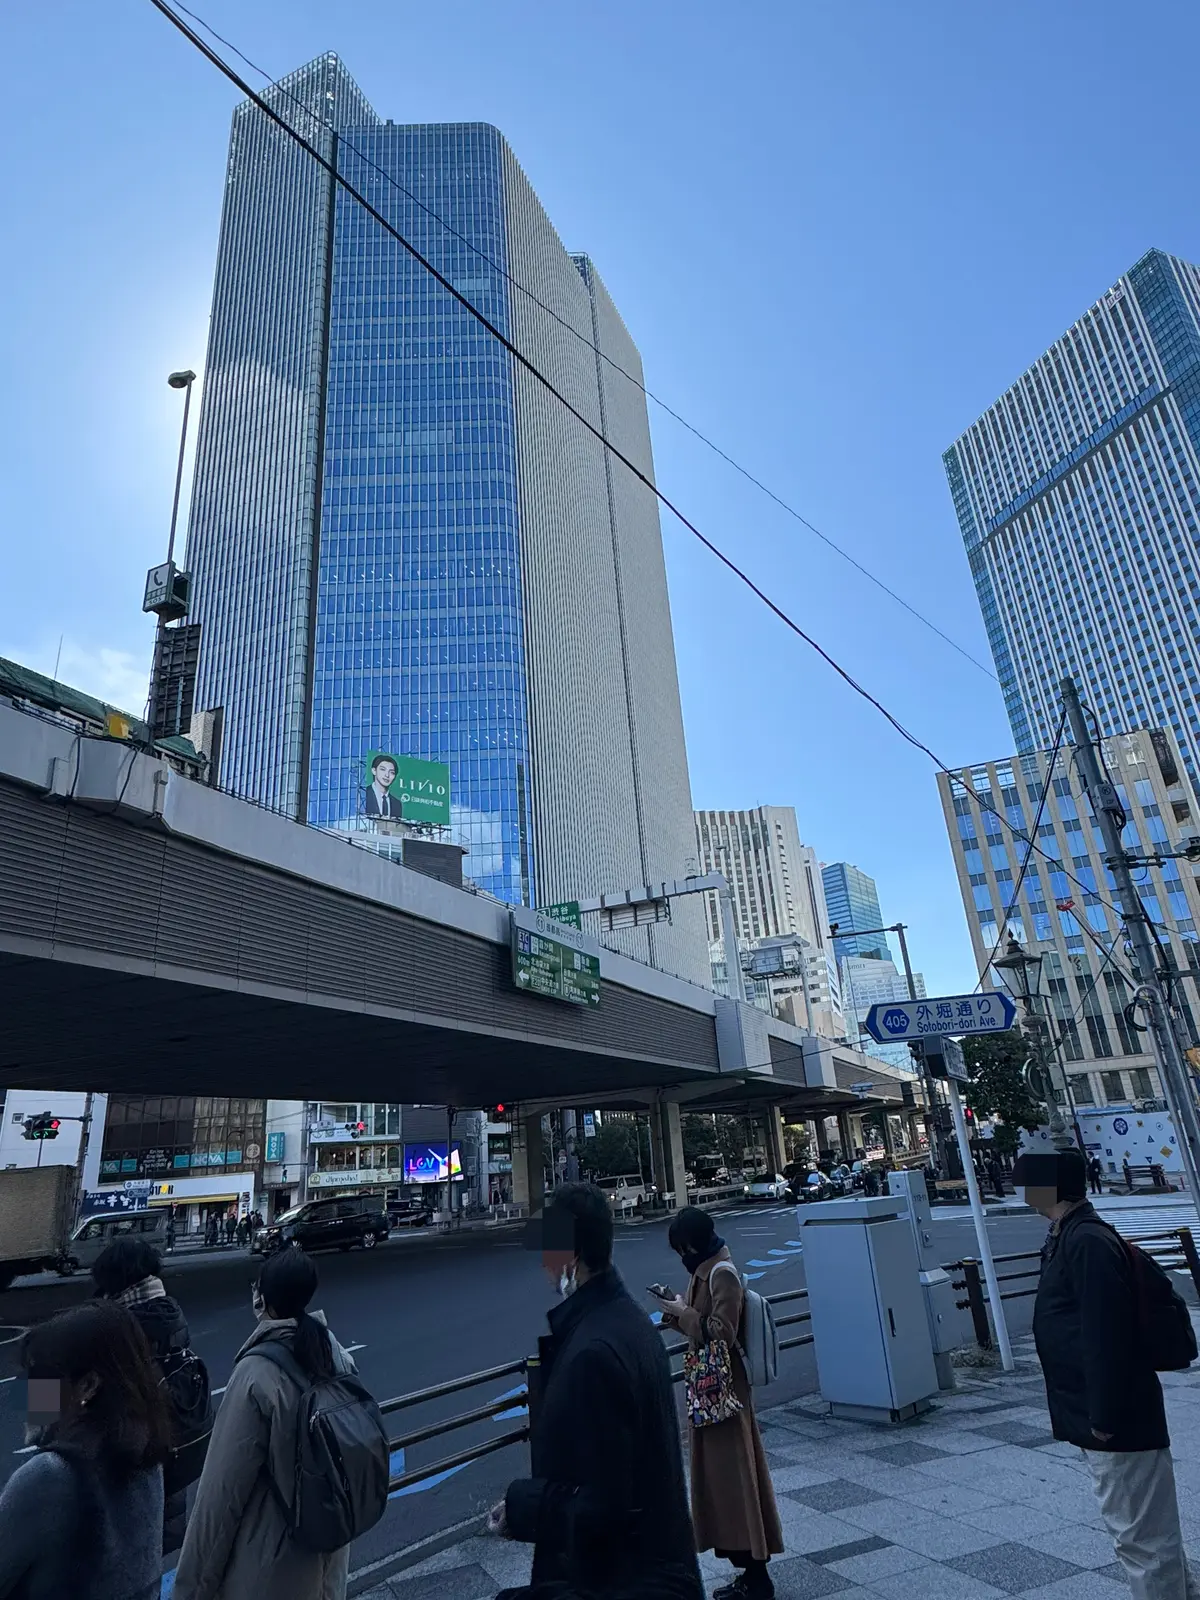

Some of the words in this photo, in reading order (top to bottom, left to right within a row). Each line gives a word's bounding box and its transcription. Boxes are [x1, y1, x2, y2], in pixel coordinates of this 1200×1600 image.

[399, 778, 445, 795] LIVIO
[551, 906, 569, 916] 渋谷
[916, 998, 992, 1021] 外堀通り
[886, 1014, 908, 1029] 405
[917, 1015, 977, 1033] Sotobori-dori
[193, 1154, 223, 1165] NOVA
